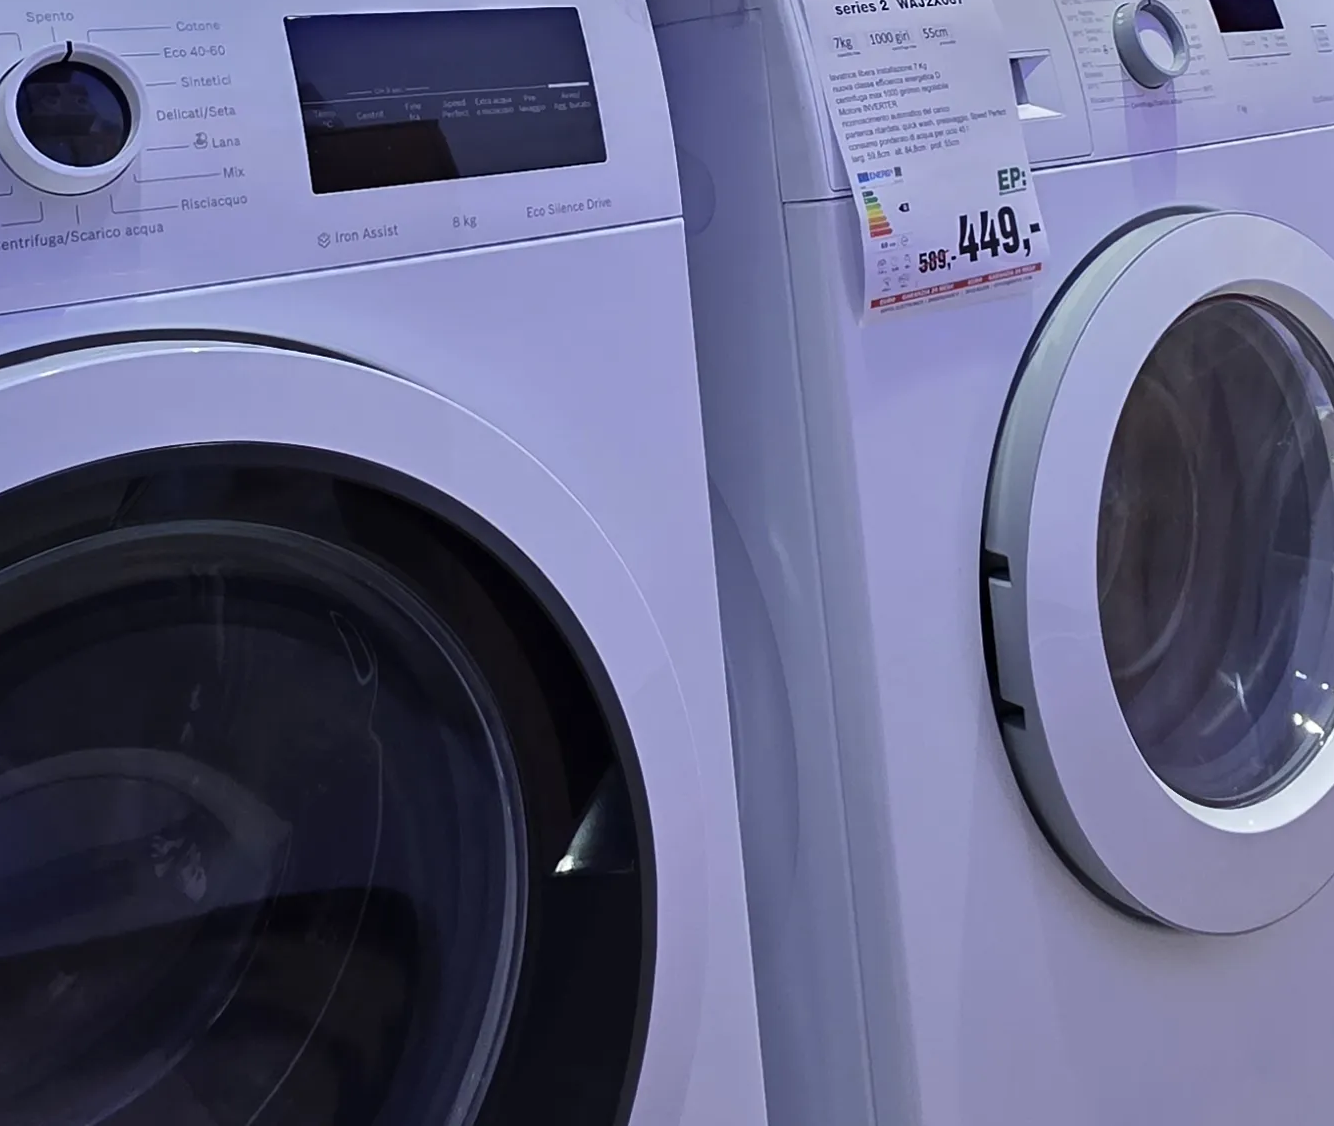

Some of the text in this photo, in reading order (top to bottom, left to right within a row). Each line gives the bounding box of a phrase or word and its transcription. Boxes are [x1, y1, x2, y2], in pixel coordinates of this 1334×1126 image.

[835, 1, 877, 15] series
[880, 0, 890, 11] 2
[26, 11, 75, 24] Spento
[176, 20, 221, 33] Cotone
[833, 27, 949, 50] 7kg 1000 giri 55cm
[163, 45, 226, 58] Eco 40-60
[180, 75, 232, 87] Sintetici
[156, 105, 237, 122] Delicati/Seta
[212, 138, 241, 149] Lana
[223, 167, 246, 178] Mix
[997, 167, 1026, 190] EP:
[181, 195, 248, 211] Risciacquo
[526, 197, 612, 219] Eco Silence Drive
[452, 215, 477, 229] 8 kg
[125, 223, 165, 238] acqua
[335, 224, 399, 244] Iron Assist
[918, 206, 1042, 274] 589,- 449,-
